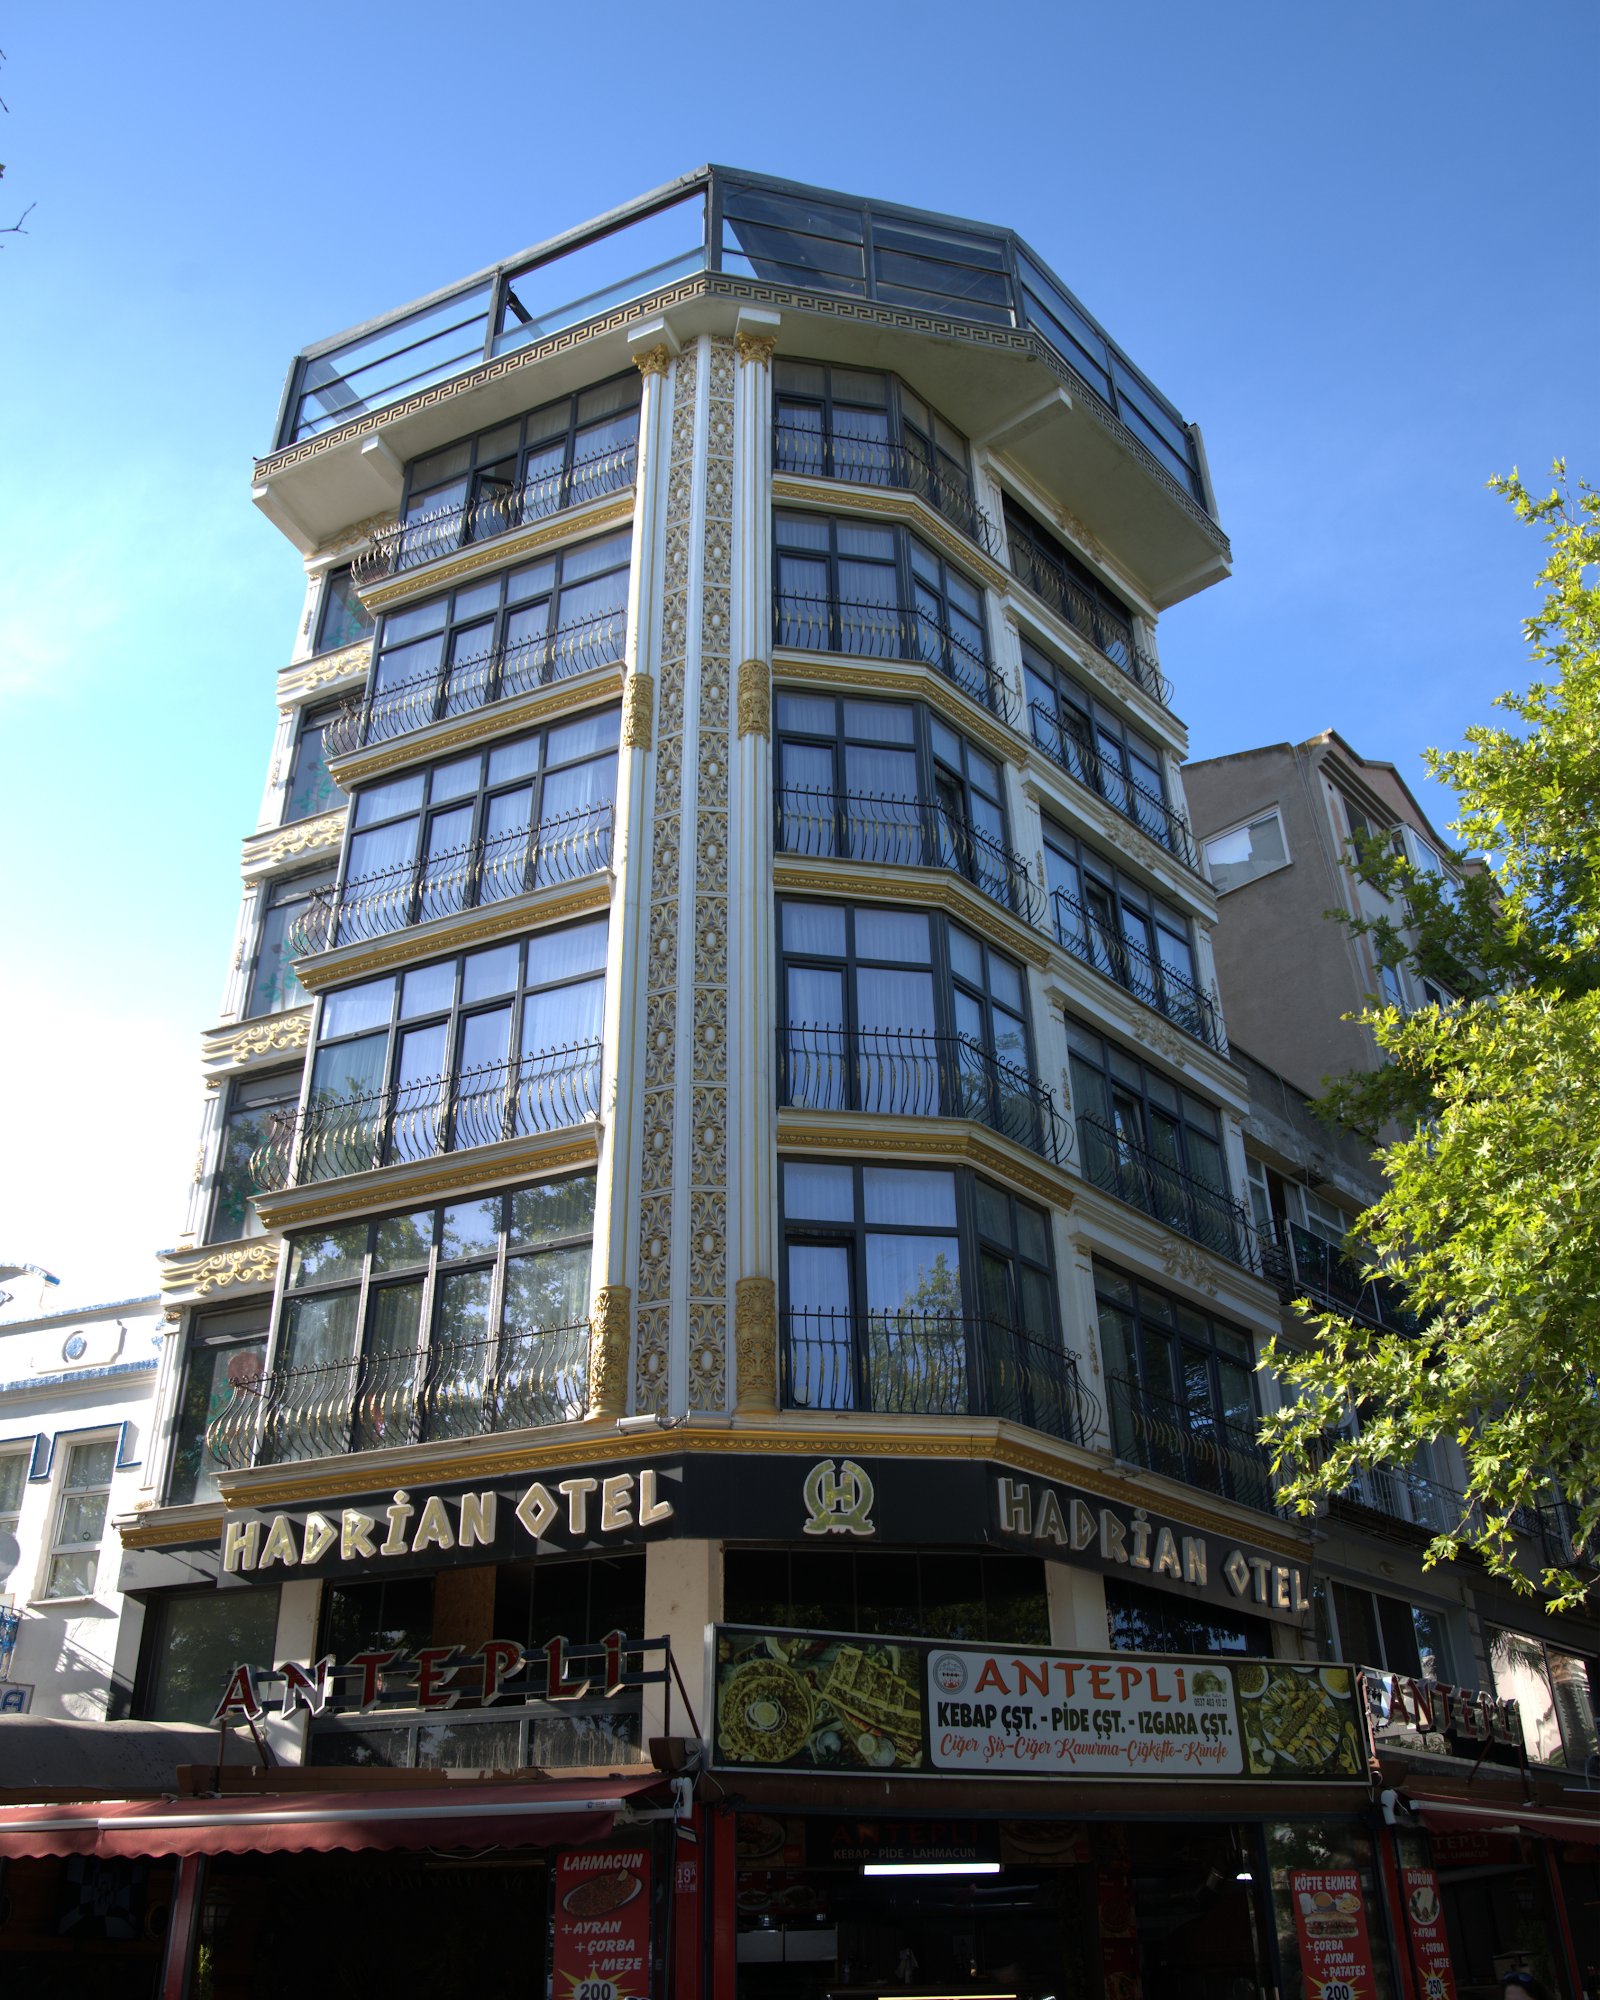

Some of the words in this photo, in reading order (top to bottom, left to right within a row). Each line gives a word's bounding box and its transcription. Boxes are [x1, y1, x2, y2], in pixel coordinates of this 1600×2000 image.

[223, 1490, 497, 1573] HADRİAN
[515, 1469, 674, 1539] OTEL
[997, 1476, 1208, 1587] HADRİAN
[1222, 1548, 1312, 1613] OTEL
[937, 1701, 997, 1729] KEBAP
[1051, 1702, 1089, 1732] PİDE
[1138, 1711, 1198, 1735] IZGARA
[940, 1733, 979, 1759] Ciğer
[563, 1853, 644, 1871] LAHMACUN
[912, 1848, 976, 1858] LAHMACUN
[1294, 1873, 1322, 1891] KÖFTE
[1325, 1875, 1357, 1891] EKMEK
[1324, 1952, 1354, 1964] AYRAN
[580, 1983, 612, 2000] 200
[1325, 1985, 1349, 2000] 200
[1428, 1979, 1442, 1995] 250
